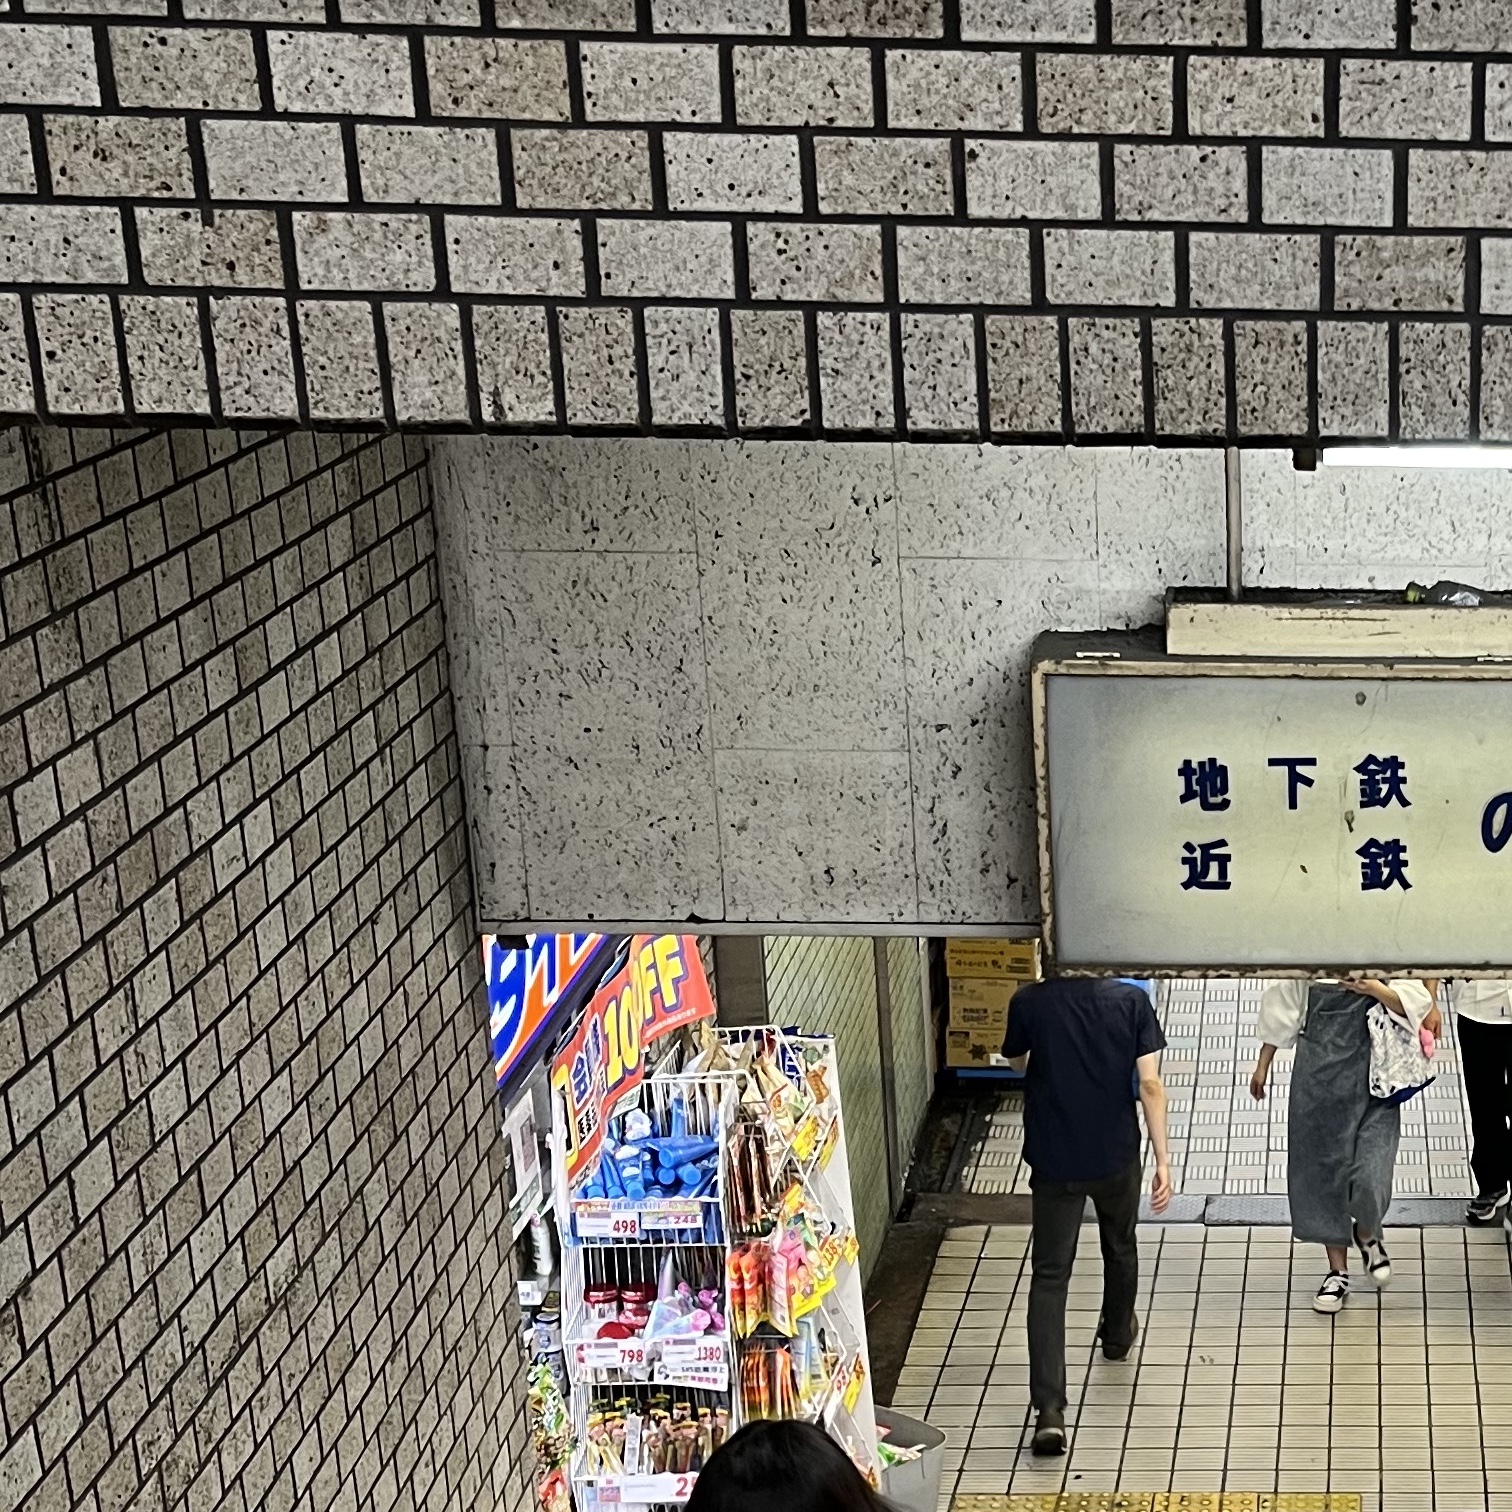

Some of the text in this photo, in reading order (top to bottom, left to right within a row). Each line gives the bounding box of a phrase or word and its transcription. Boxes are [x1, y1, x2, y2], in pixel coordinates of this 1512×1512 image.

[1178, 753, 1411, 811] 地下鉄
[1180, 837, 1412, 892] 近鉄
[613, 1219, 637, 1234] 498
[620, 1349, 644, 1363] 798
[696, 1346, 721, 1361] 1380
